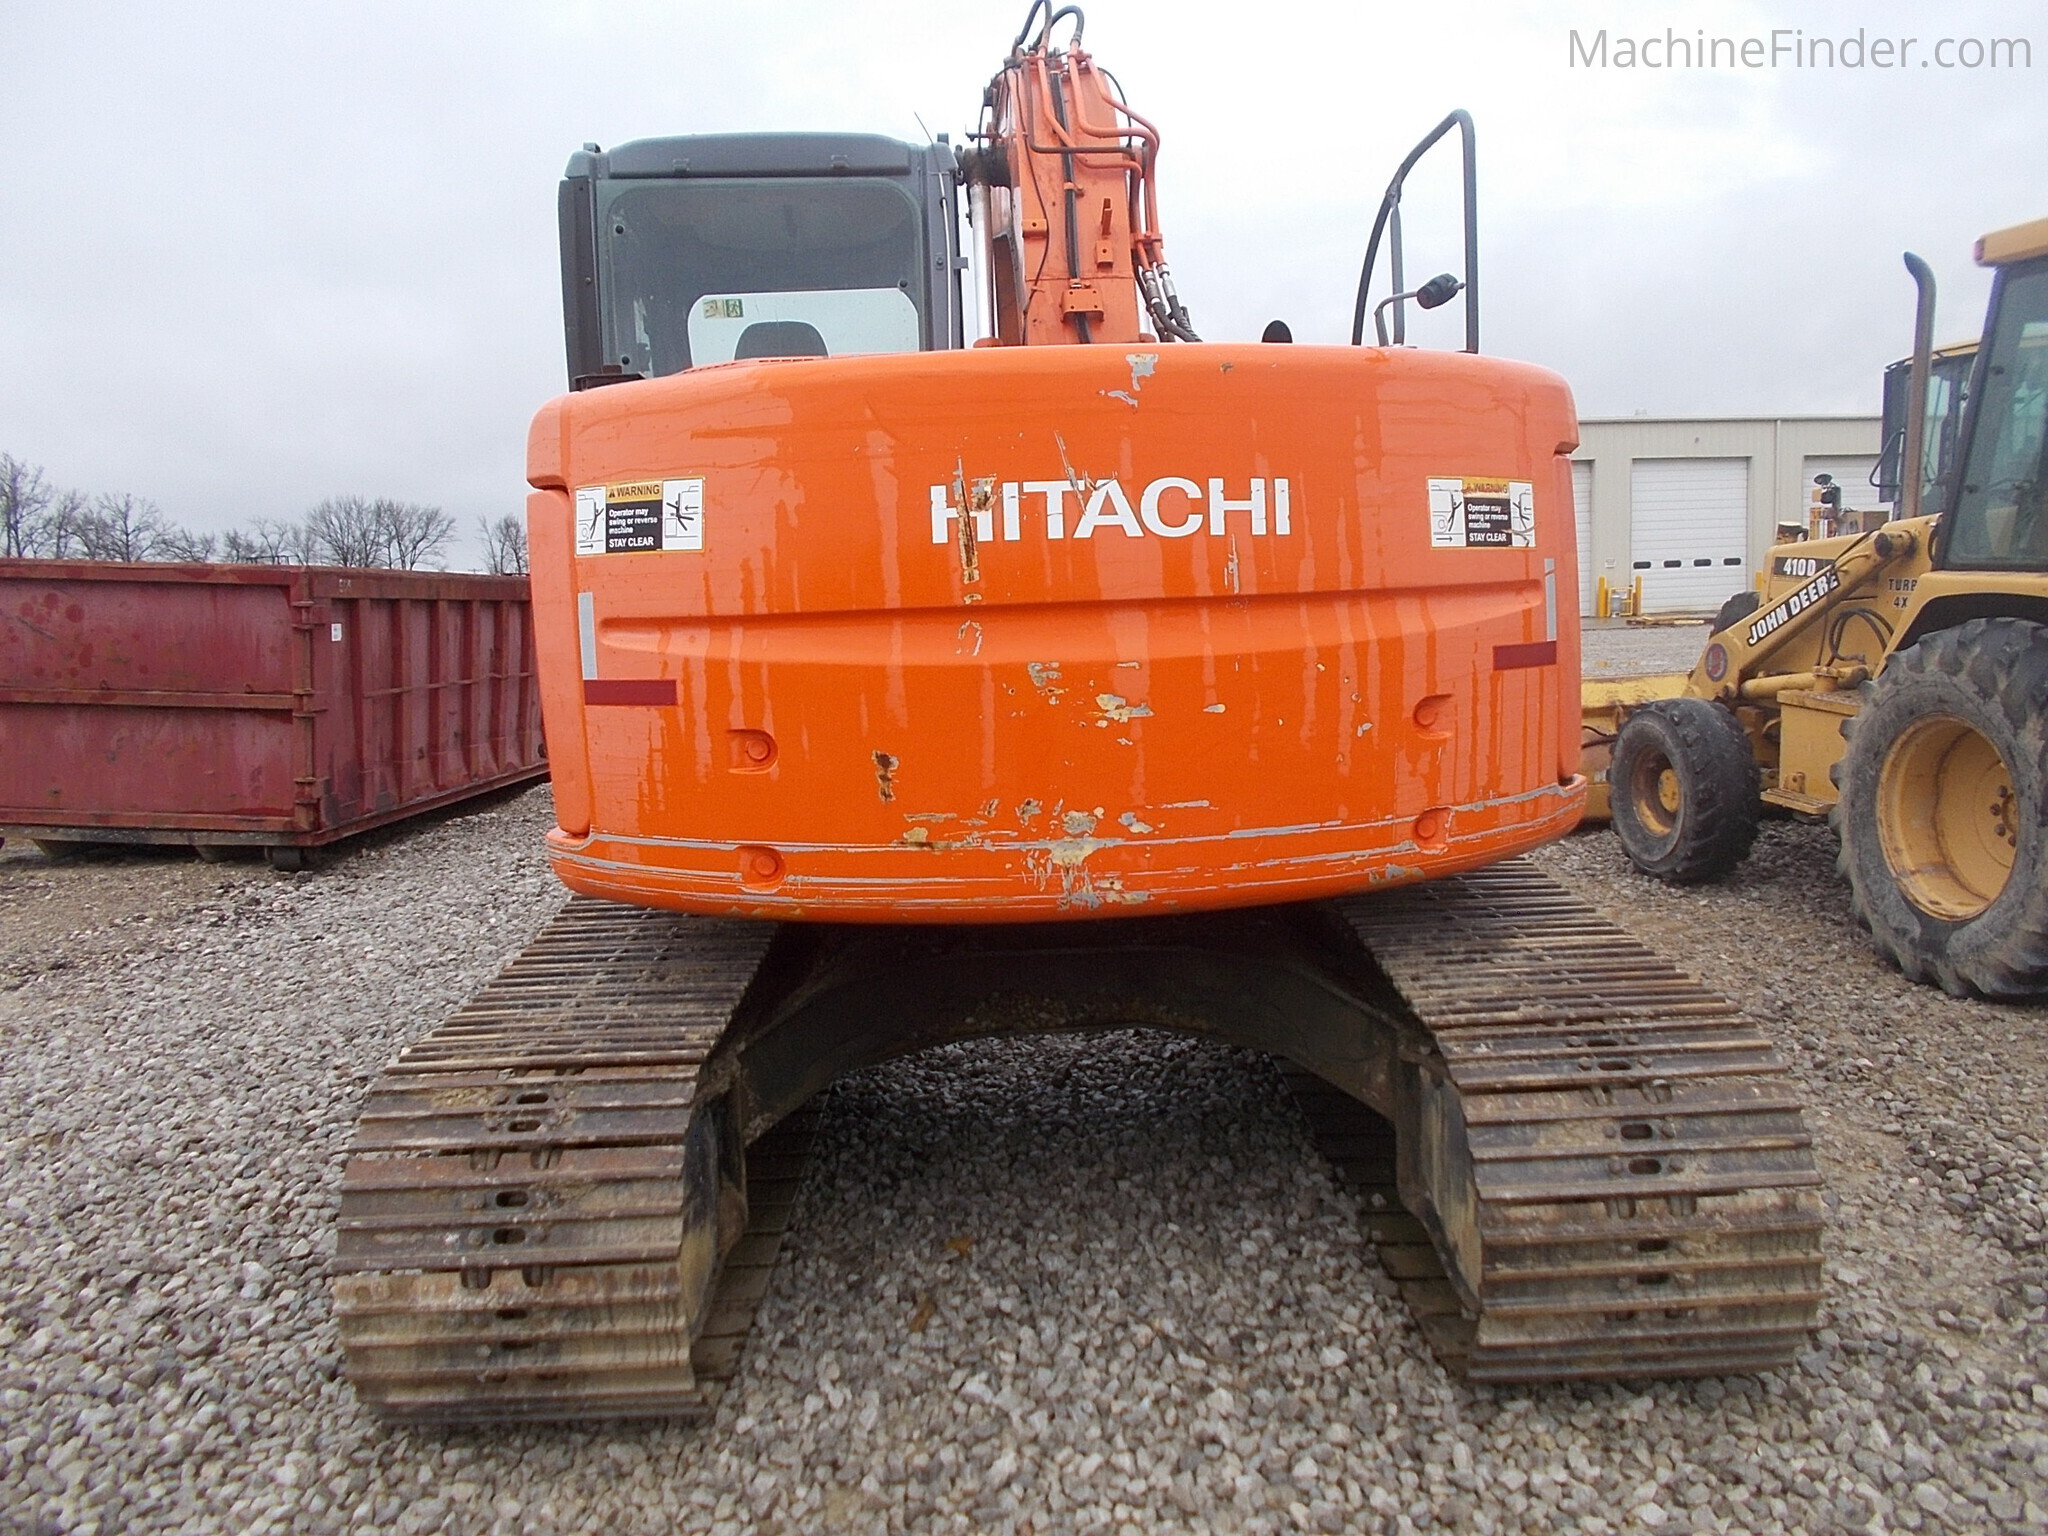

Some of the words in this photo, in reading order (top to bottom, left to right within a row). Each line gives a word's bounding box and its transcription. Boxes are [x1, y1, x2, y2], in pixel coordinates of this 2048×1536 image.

[617, 485, 660, 497] WARNING
[1474, 483, 1507, 493] WARNING
[609, 509, 634, 518] Operator
[930, 477, 1291, 544] HITACHI
[1468, 504, 1490, 513] Operator
[1468, 512, 1484, 521] swing
[609, 518, 626, 526] swing
[609, 538, 627, 548] STAY
[627, 536, 654, 547] CLEAR
[1469, 533, 1485, 541] STAY
[1486, 533, 1507, 541] CLEAR
[1783, 558, 1817, 577] 410D
[1748, 603, 1789, 645] JOHN
